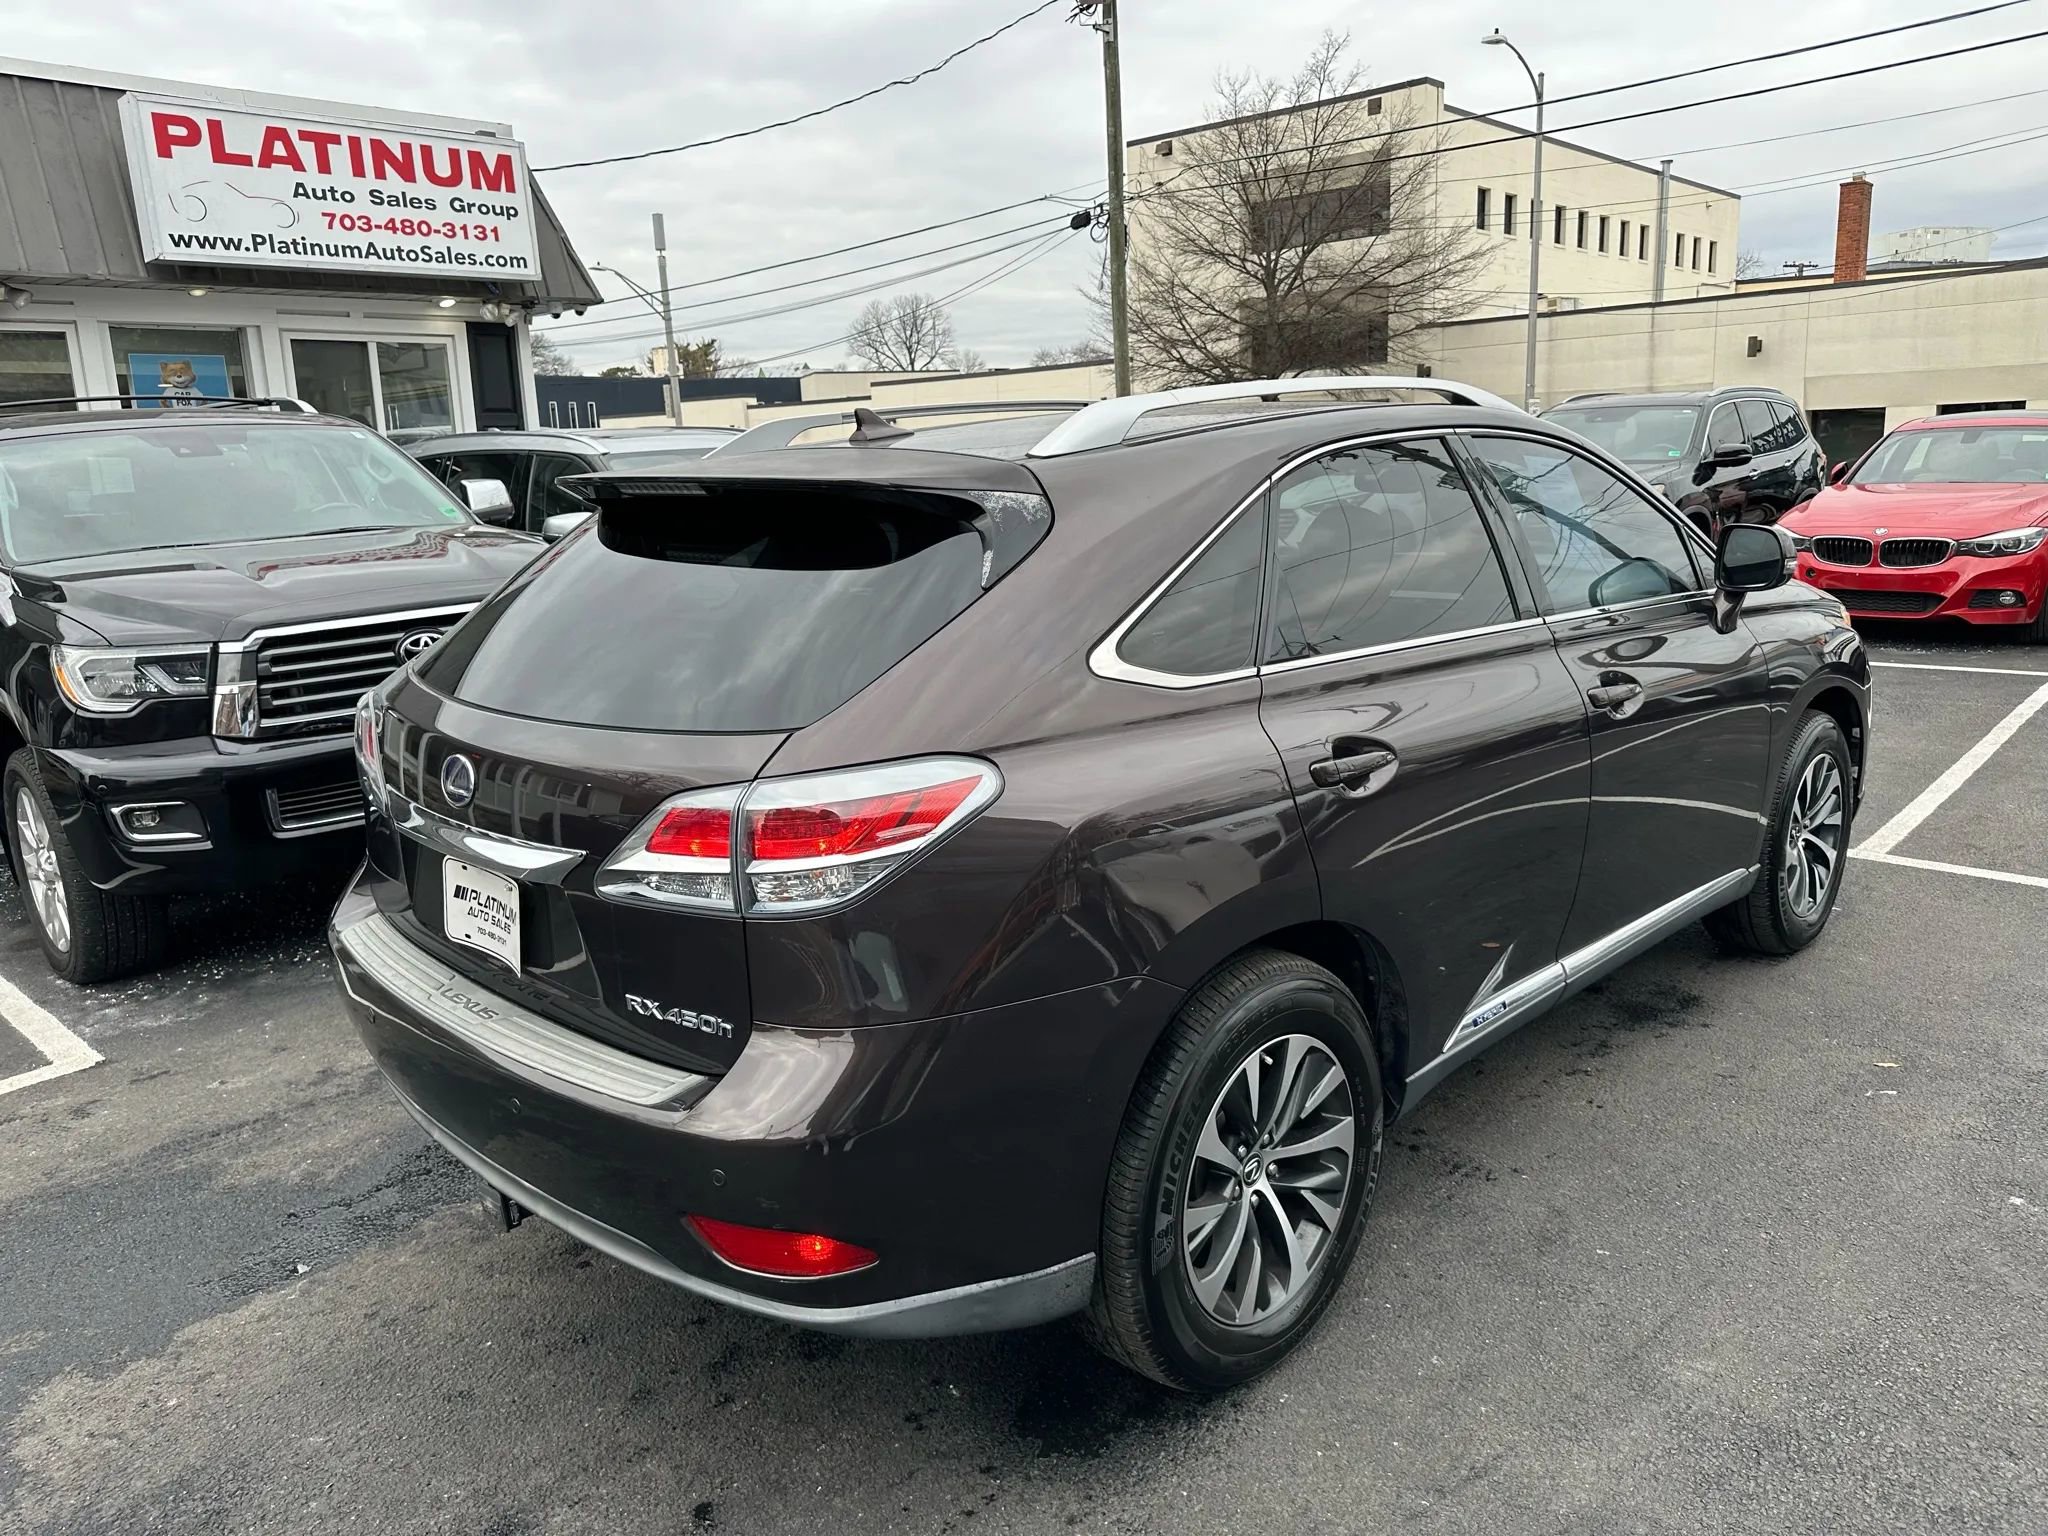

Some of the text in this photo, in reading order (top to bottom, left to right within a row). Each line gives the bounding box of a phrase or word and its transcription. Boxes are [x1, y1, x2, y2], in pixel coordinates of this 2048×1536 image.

[150, 111, 517, 194] PLATINUM
[292, 181, 519, 220] Auto Sales Group
[321, 211, 501, 243] 703-480-3131
[168, 232, 528, 269] www.PlatinumAutoSales.com
[467, 906, 511, 935] AUTO SALES
[468, 889, 517, 926] PLATINUM
[476, 926, 507, 946] 703-480-3131
[440, 987, 500, 1020] LEXUS
[625, 993, 734, 1039] RX450h
